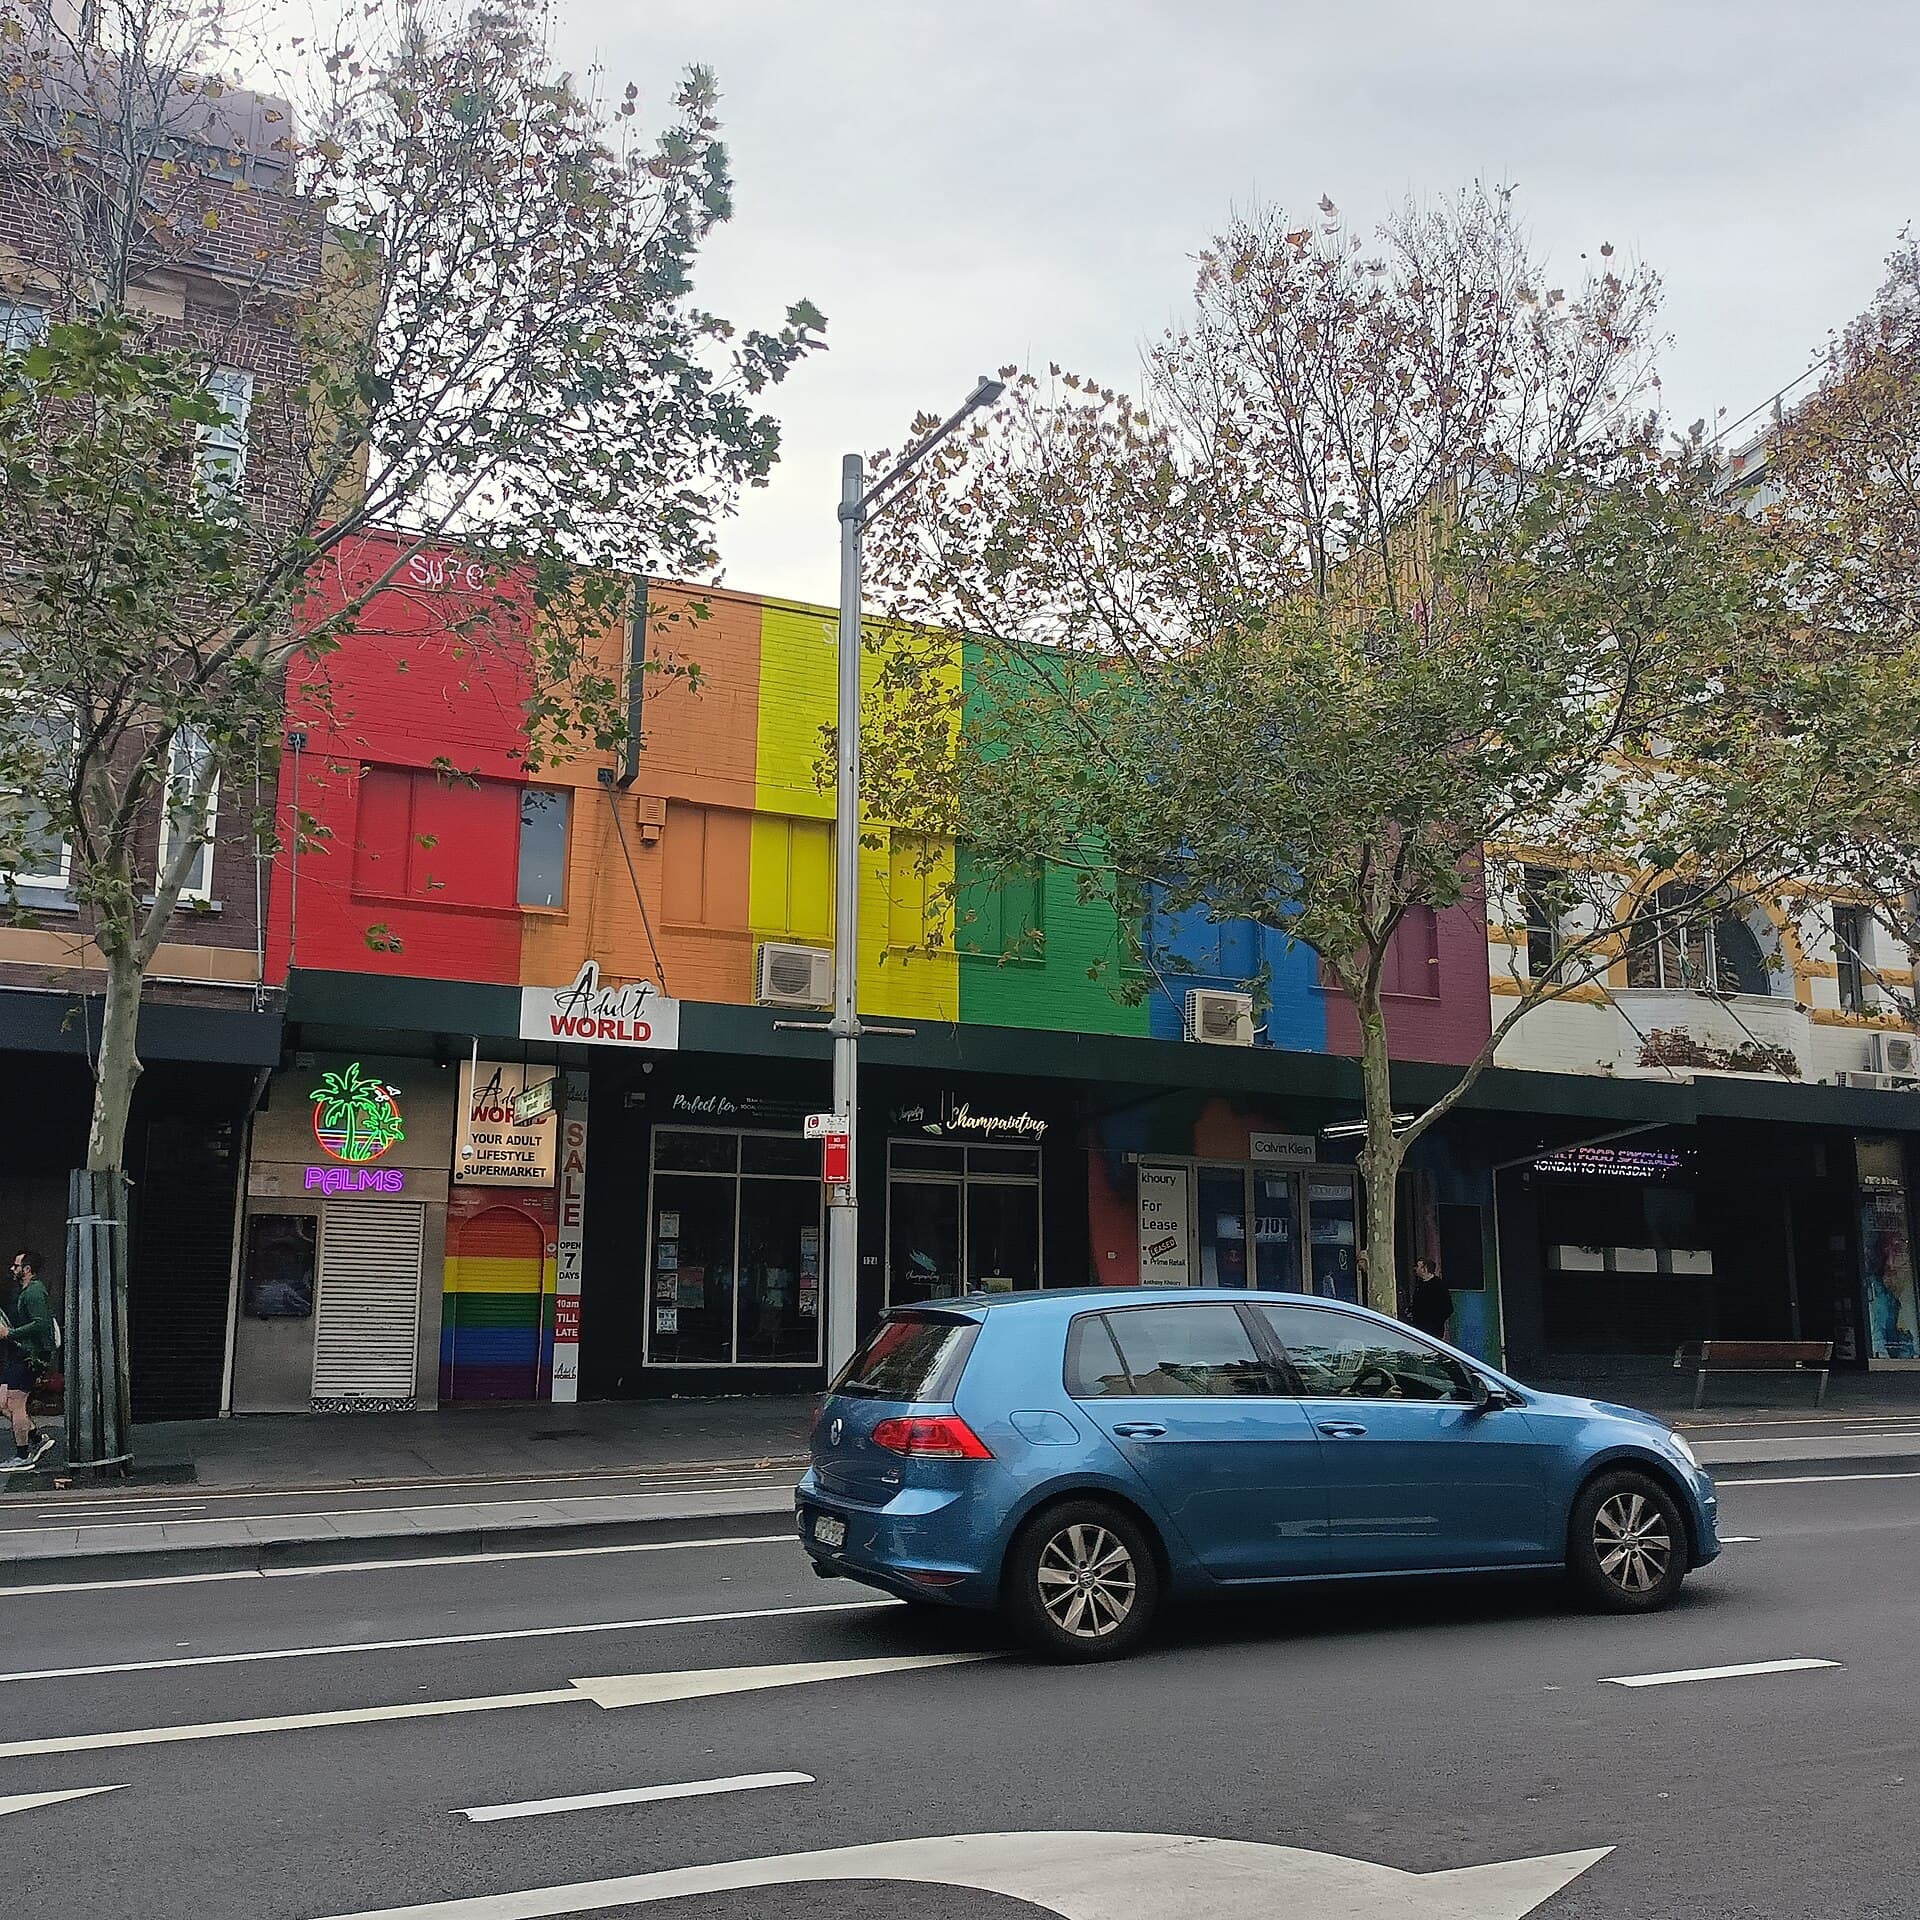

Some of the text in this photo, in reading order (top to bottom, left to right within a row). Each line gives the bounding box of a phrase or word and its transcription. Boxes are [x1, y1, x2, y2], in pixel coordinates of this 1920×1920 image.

[554, 966, 655, 1024] Adult
[550, 1014, 652, 1042] WORLD
[672, 1094, 738, 1115] Perfect for
[809, 1116, 819, 1128] C
[471, 1133, 543, 1147] YOUR ADULT
[1255, 1140, 1312, 1155] Calvin Klein
[476, 1149, 536, 1162] LIFESTYLE
[463, 1164, 547, 1178] SUPERMARKET
[563, 1122, 584, 1228] SALE
[1580, 1162, 1596, 1174] TO
[1597, 1163, 1656, 1177] THURSDAY
[304, 1166, 405, 1196] PALMS
[1141, 1172, 1176, 1186] khoury
[1142, 1200, 1162, 1212] For
[1142, 1218, 1178, 1231] Lease
[559, 1241, 582, 1250] OPEN
[1150, 1239, 1176, 1256] LEASED
[564, 1252, 577, 1269] 7
[558, 1271, 580, 1281] DAYS
[556, 1299, 580, 1309] 10am
[556, 1312, 579, 1324] TILL
[555, 1327, 579, 1338] LATE
